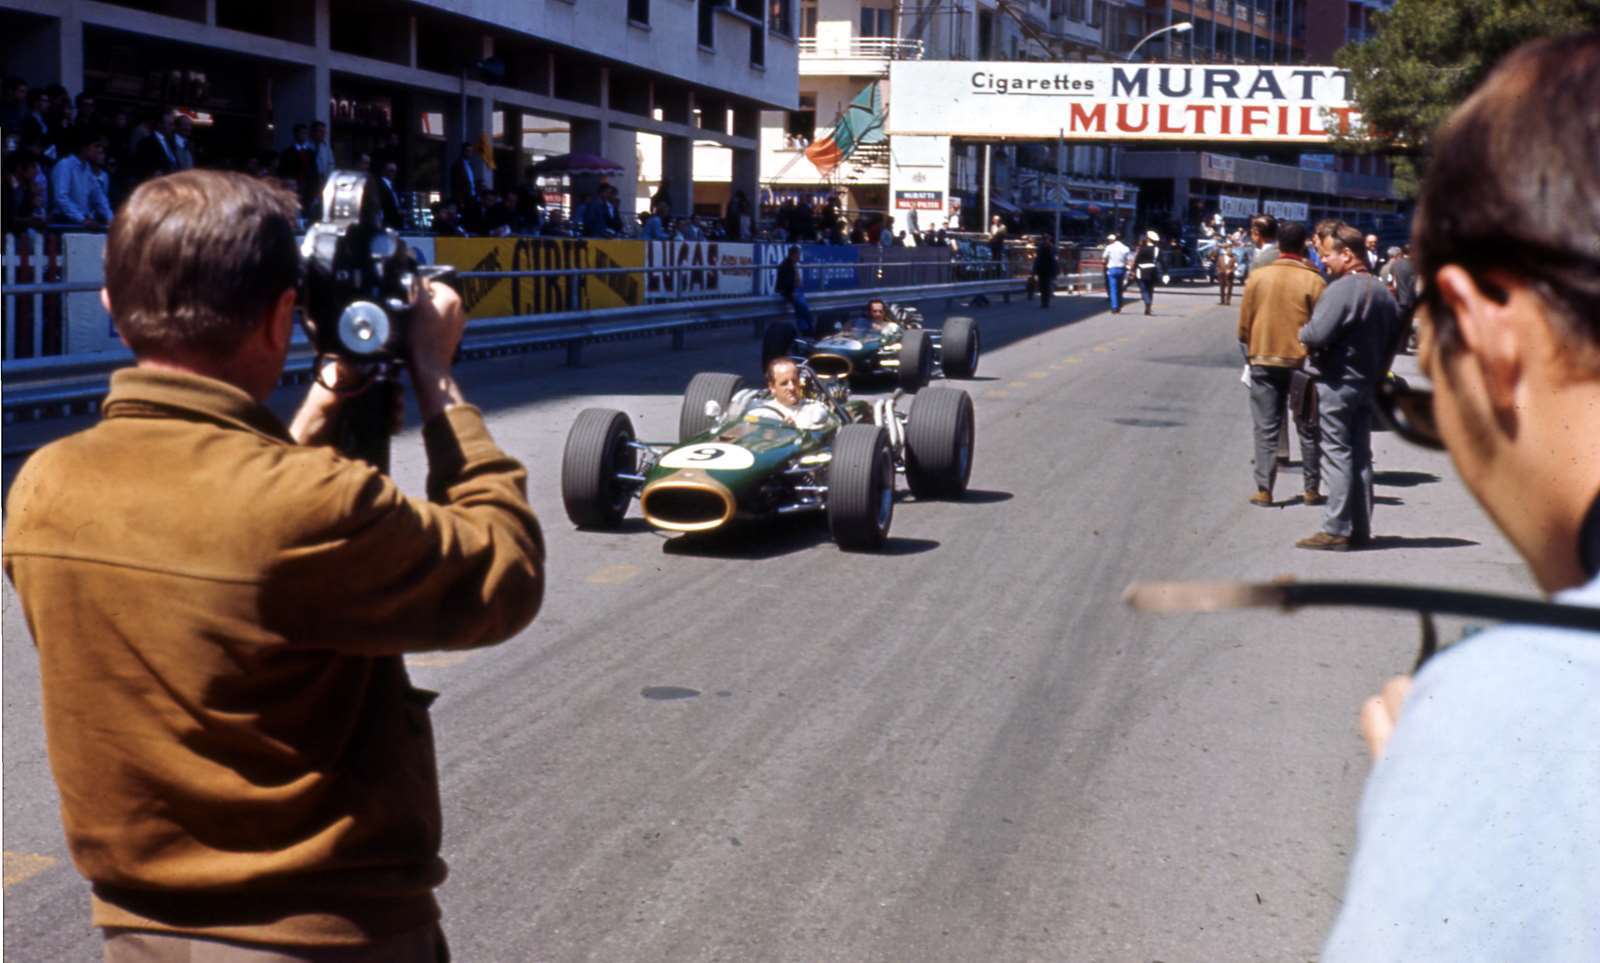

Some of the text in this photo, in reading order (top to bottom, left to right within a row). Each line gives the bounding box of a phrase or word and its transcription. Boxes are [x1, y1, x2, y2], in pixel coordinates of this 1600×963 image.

[971, 72, 1095, 95] Cigarettes
[647, 240, 719, 292] LUCAS
[687, 447, 726, 461] 9
